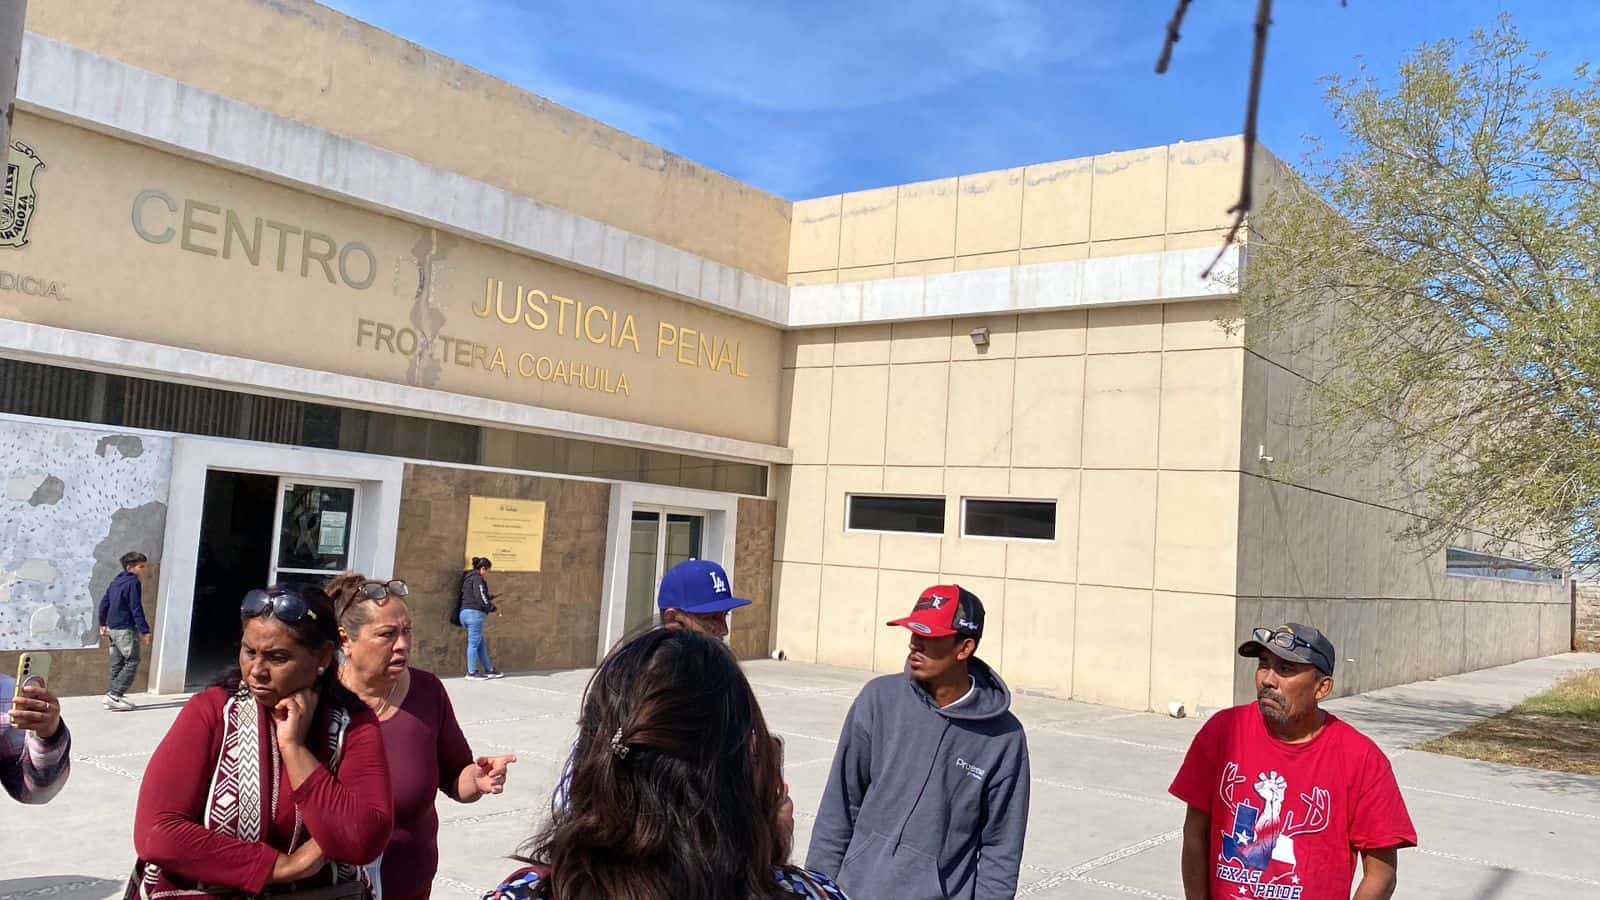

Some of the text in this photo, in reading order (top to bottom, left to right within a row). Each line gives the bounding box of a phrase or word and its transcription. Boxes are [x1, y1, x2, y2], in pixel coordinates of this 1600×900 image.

[131, 188, 377, 290] CENTRO
[472, 277, 640, 353] JUSTICIA
[656, 321, 749, 377] PENAL
[357, 318, 631, 397] FROTERA, COAHUILA
[709, 571, 727, 593] LA
[1216, 863, 1263, 885] TEXAS
[1254, 883, 1303, 900] PRIDE
